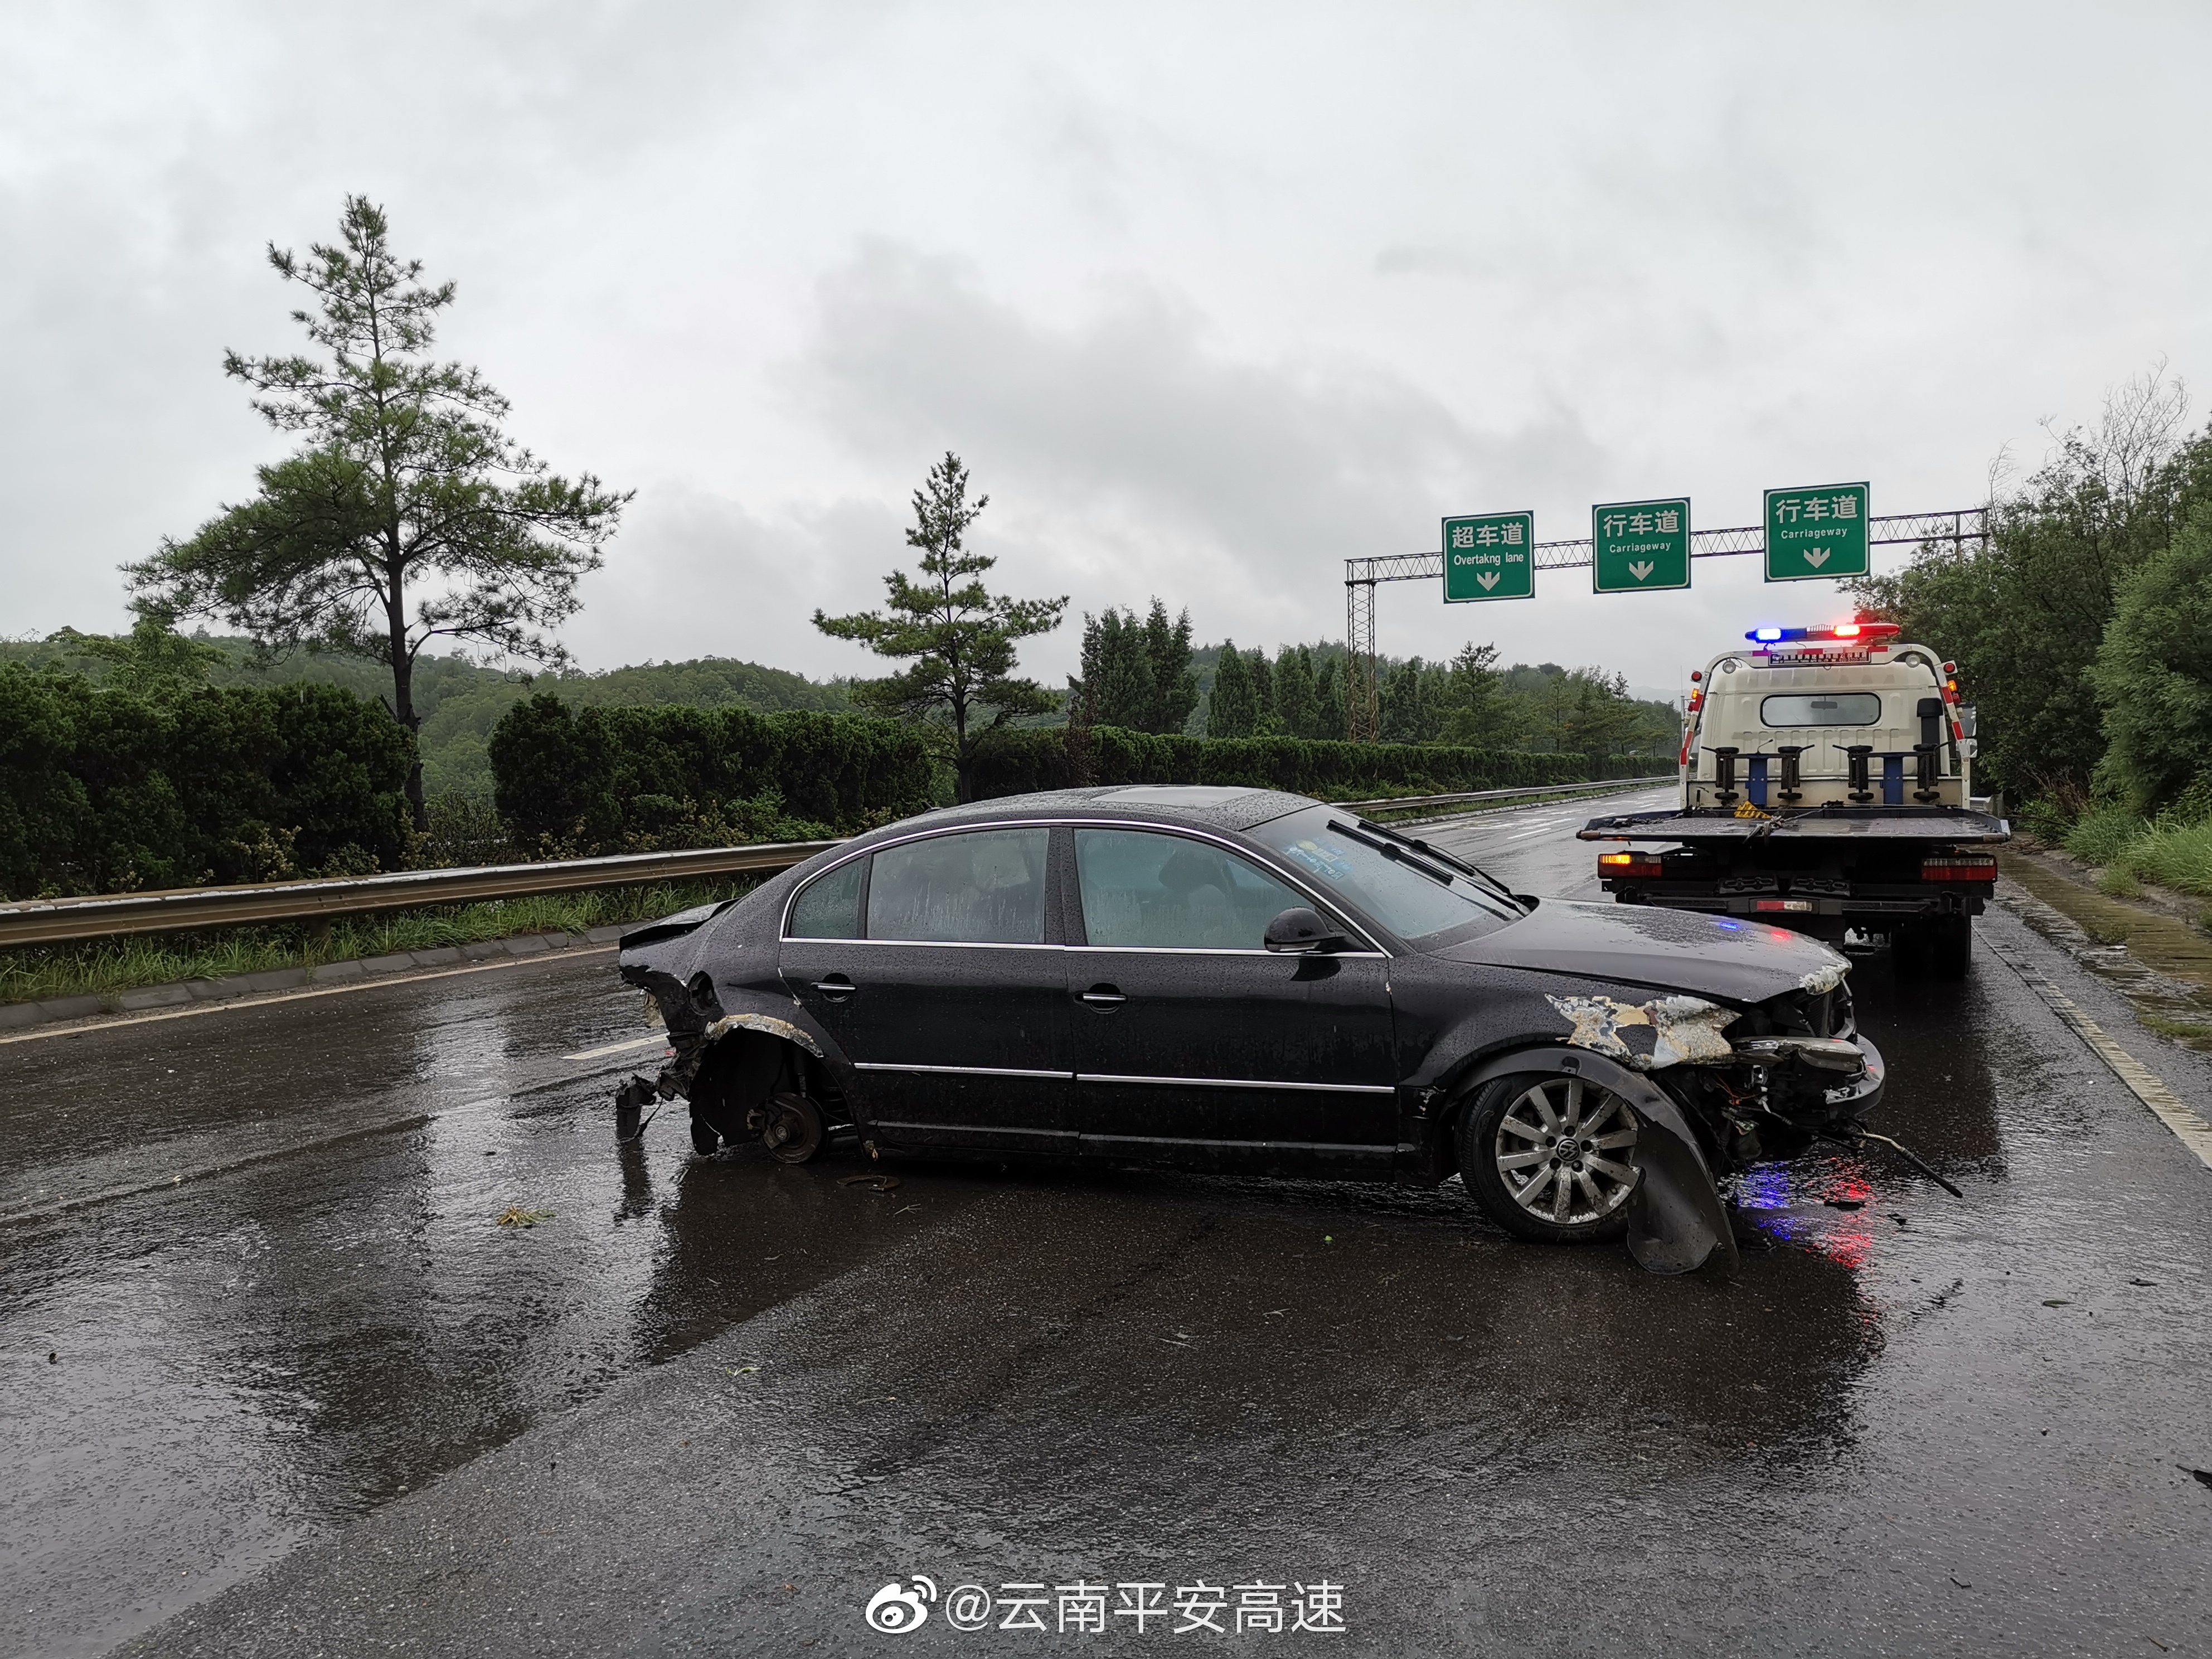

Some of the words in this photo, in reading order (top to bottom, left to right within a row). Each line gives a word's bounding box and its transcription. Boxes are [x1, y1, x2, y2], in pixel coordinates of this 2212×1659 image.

[1776, 494, 1858, 523] 行车道
[1603, 510, 1680, 537] 行车道
[1781, 528, 1847, 539] Carriageway
[1452, 522, 1524, 549] 超车道
[1609, 542, 1671, 553] Carriageway
[1454, 553, 1501, 566] Overtakng
[1506, 552, 1524, 563] lane
